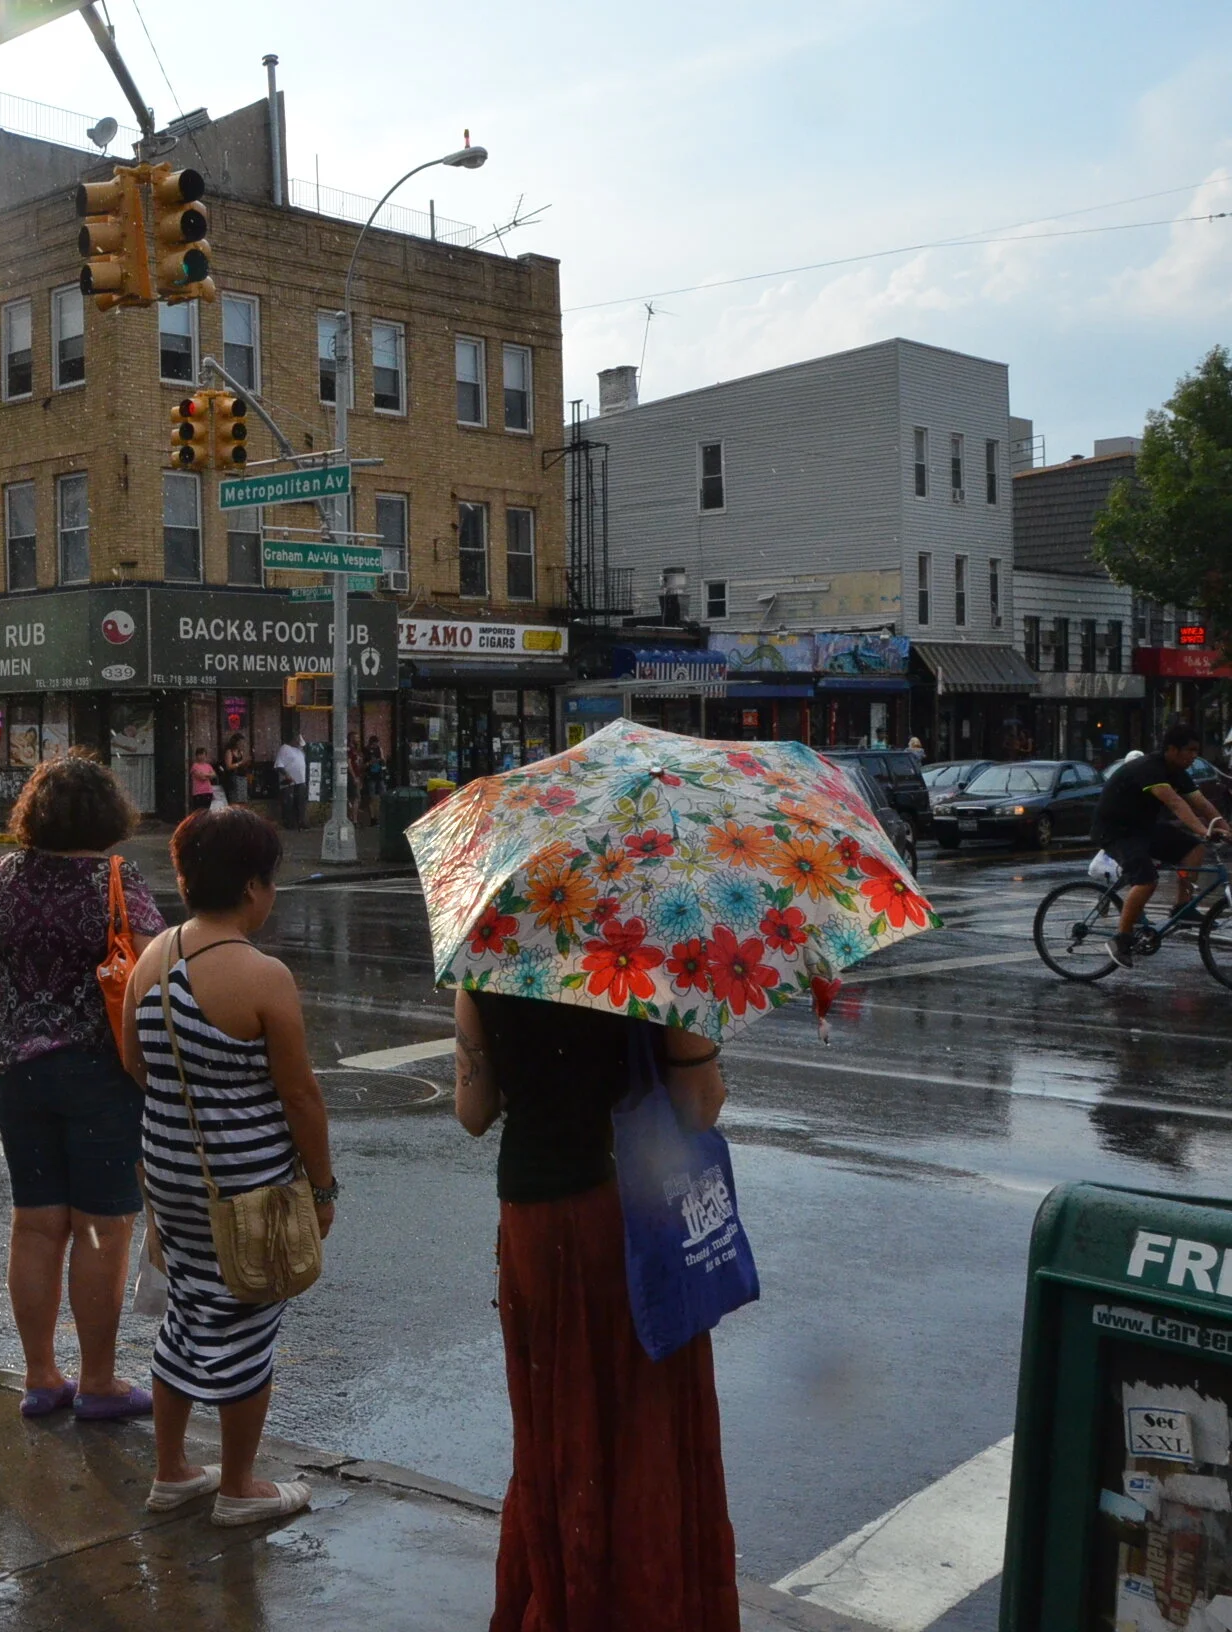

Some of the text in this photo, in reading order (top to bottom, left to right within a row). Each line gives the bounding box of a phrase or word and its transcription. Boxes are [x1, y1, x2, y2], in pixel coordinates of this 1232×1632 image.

[225, 474, 344, 502] Metropolitan Av
[264, 548, 383, 569] Graham Av-Via Vespucci
[5, 622, 46, 648] RUB
[262, 620, 319, 643] FOOT
[479, 627, 516, 635] IMPORTED
[479, 636, 516, 649] CIGARS
[204, 653, 239, 671] FOR
[104, 667, 134, 678] 339
[1097, 1311, 1232, 1353] www.Caree
[1143, 1413, 1178, 1430] Sec
[1135, 1434, 1190, 1454] XXL
